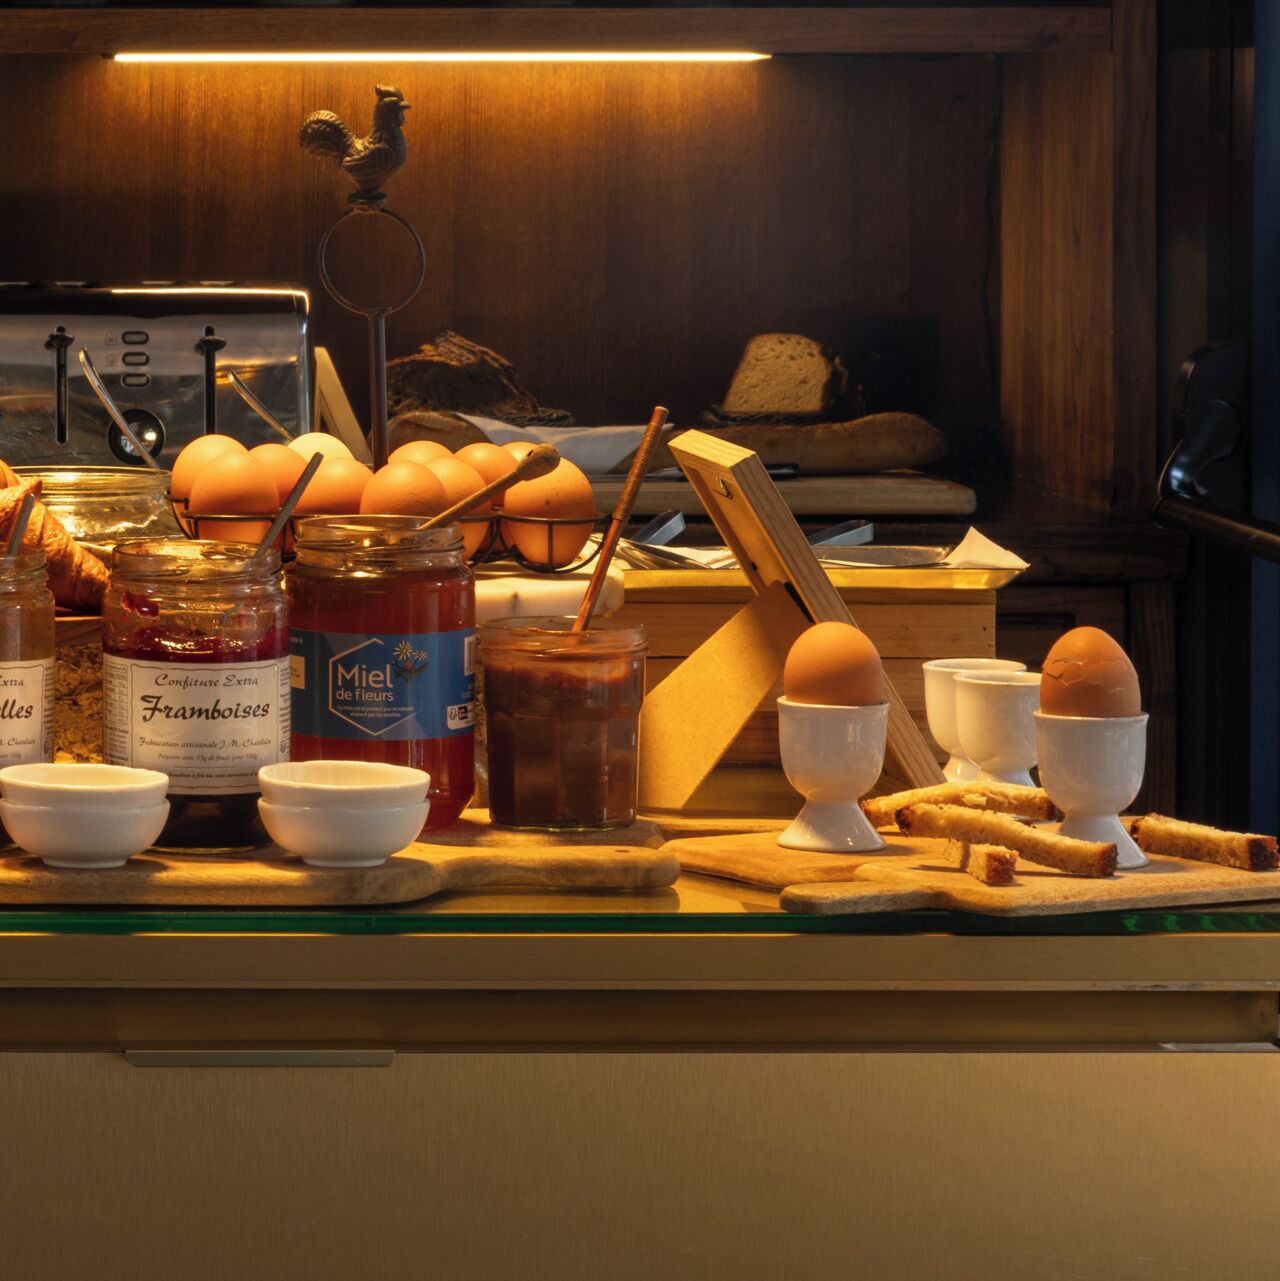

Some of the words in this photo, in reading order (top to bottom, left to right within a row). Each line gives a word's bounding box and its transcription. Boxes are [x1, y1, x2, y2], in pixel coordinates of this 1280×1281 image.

[155, 673, 220, 689] Confiture
[222, 674, 258, 688] Extra
[337, 663, 394, 688] Miel
[336, 688, 352, 701] de
[355, 688, 394, 701] fleurs
[140, 694, 270, 723] Framboises
